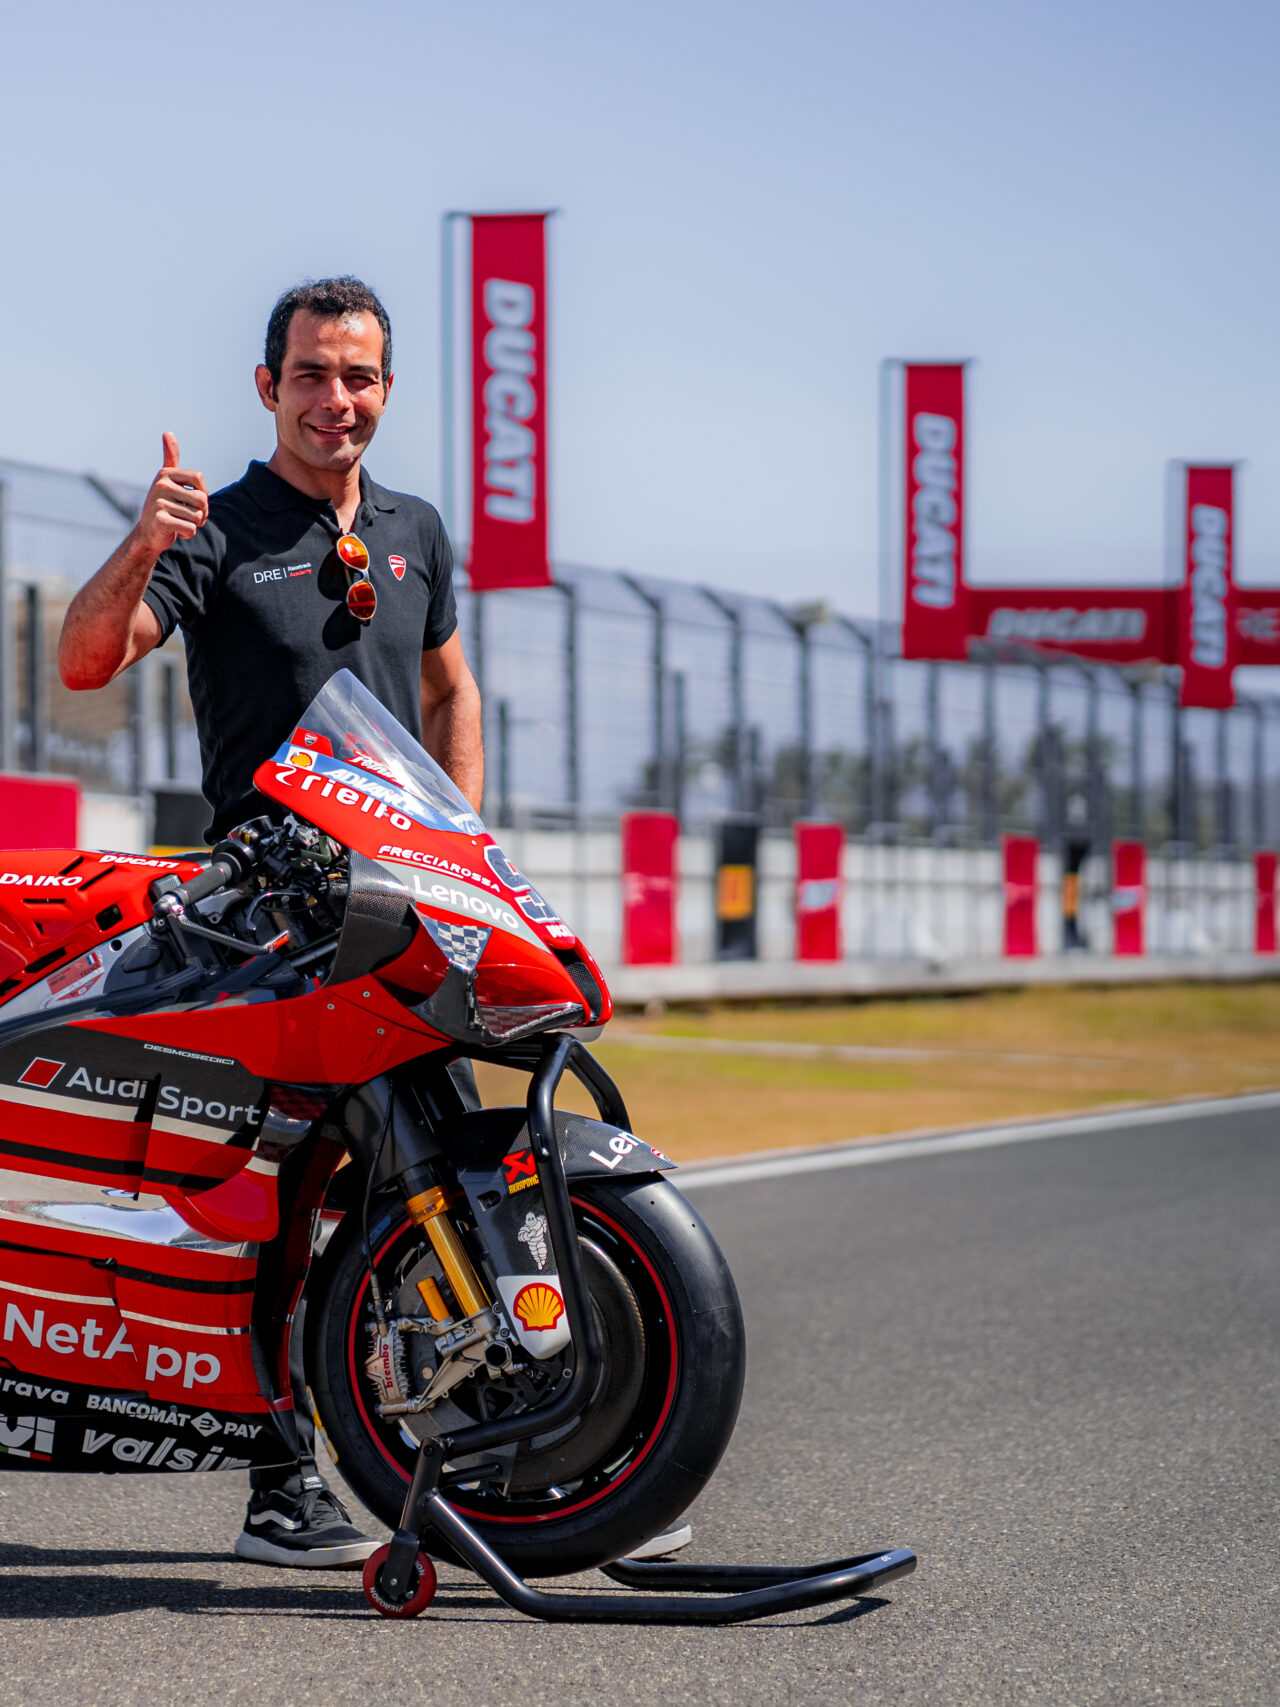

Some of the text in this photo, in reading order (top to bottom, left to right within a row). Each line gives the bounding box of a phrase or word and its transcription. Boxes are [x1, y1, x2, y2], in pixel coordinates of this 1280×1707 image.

[484, 277, 536, 524] DUCATI
[913, 411, 957, 608] DUCATI
[253, 568, 282, 583] DRE
[300, 773, 412, 831] riello
[0, 872, 83, 887] DAIKO
[99, 855, 180, 868] DUCATI
[378, 845, 500, 893] FRECCIAROSSA
[413, 874, 520, 930] Lenovo
[143, 1043, 235, 1066] DESMOSEDICI
[65, 1066, 261, 1126] Audi Sport
[3, 1303, 221, 1389] NetApp
[381, 1344, 393, 1388] brembo
[86, 1394, 263, 1440] BANCOMAT PAY
[82, 1429, 252, 1472] valsir
